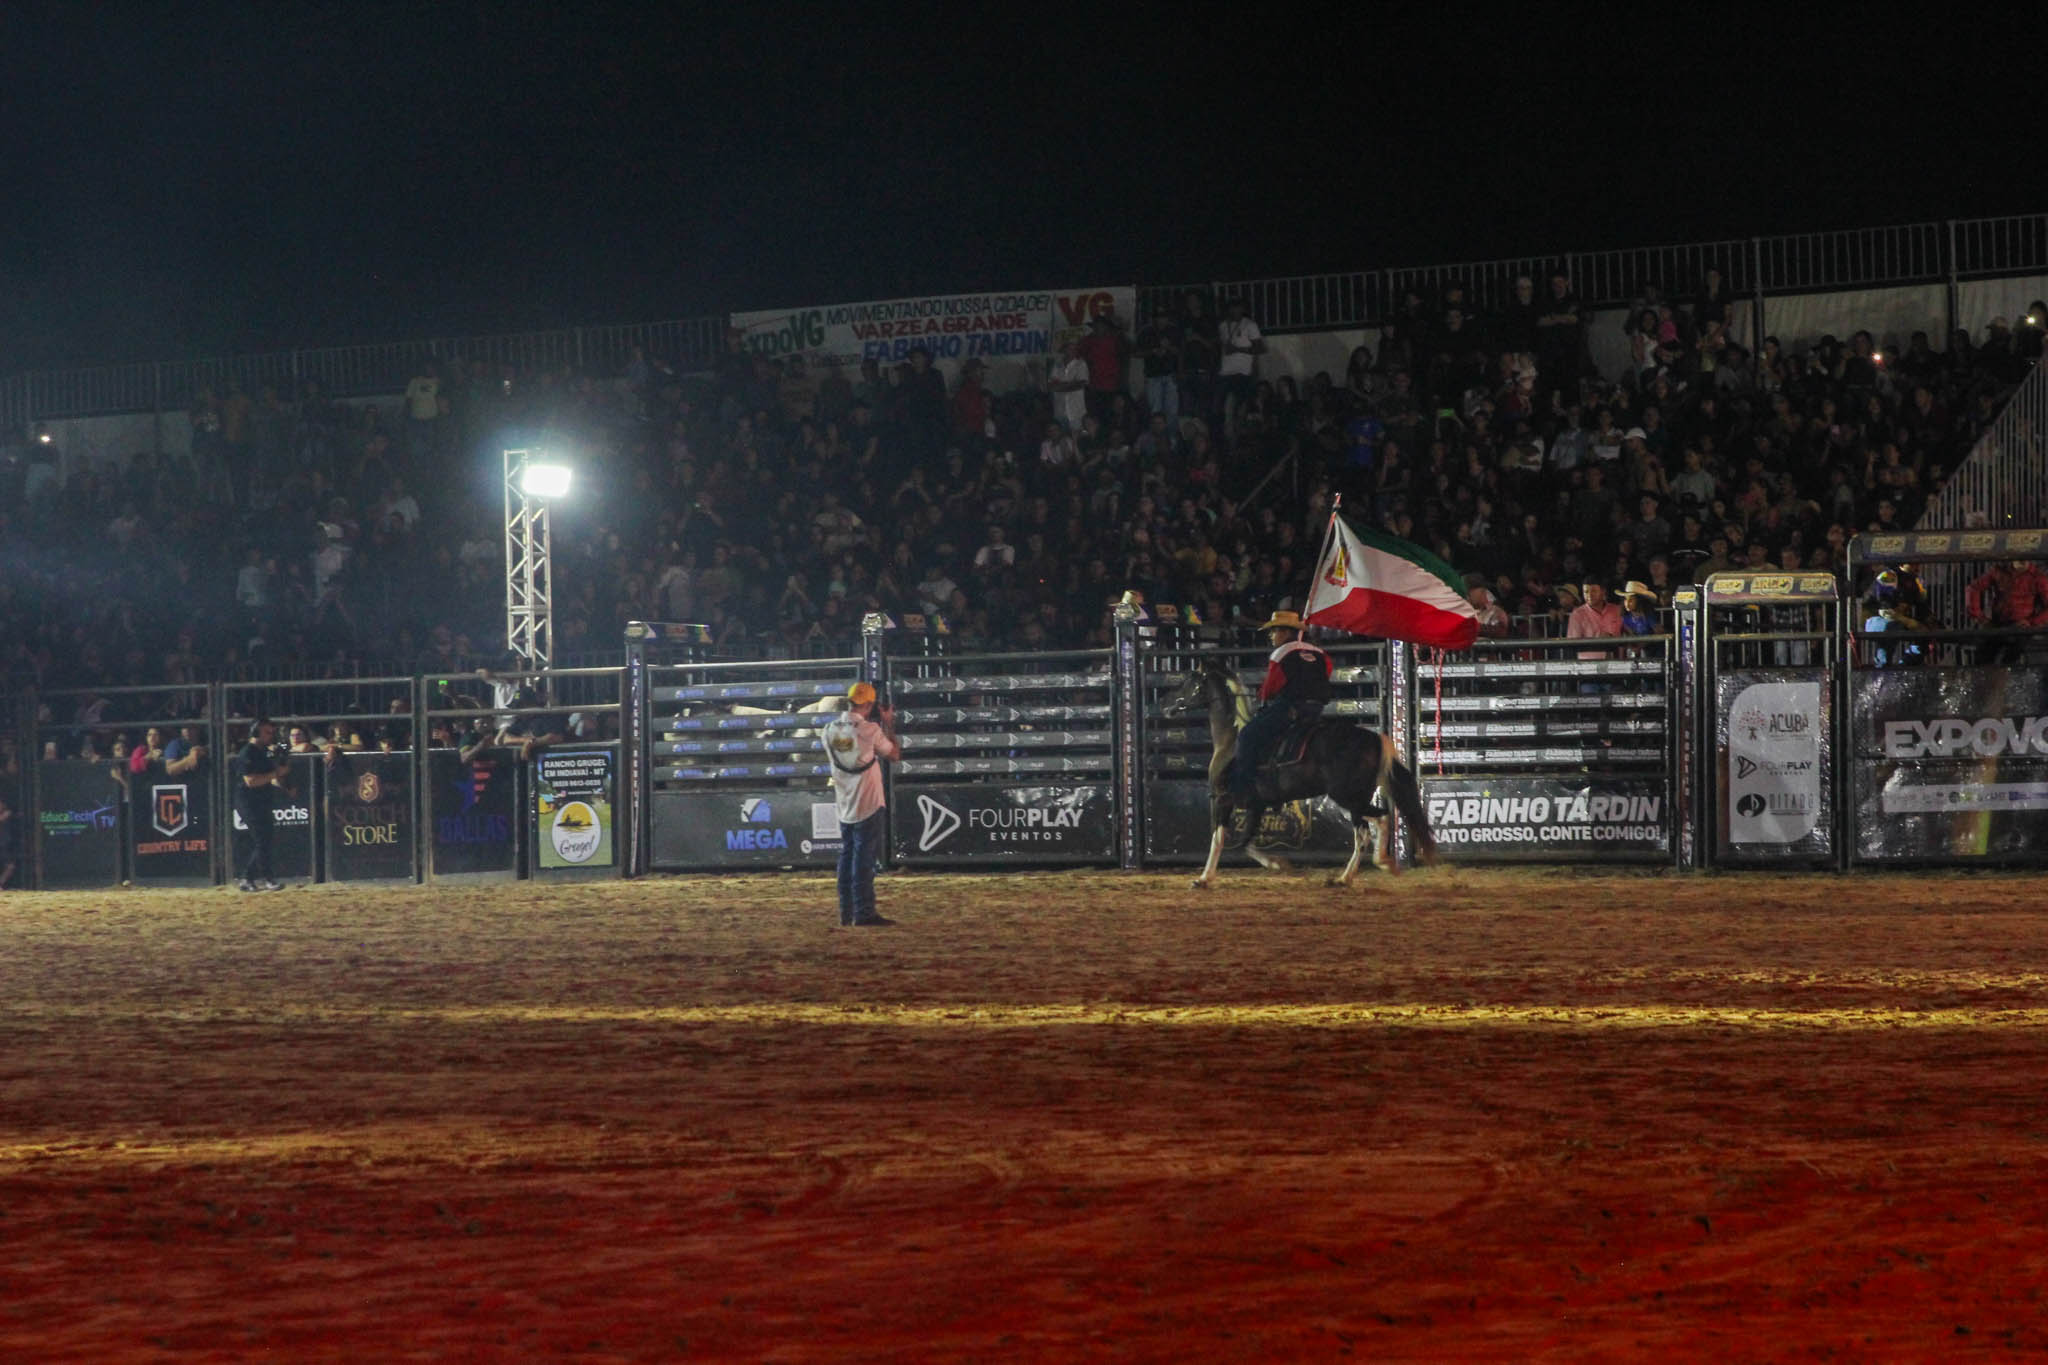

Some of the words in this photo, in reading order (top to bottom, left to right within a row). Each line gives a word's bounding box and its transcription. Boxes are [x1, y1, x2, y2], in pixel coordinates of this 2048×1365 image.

[826, 300, 942, 326] MOVIMENTANDO
[943, 296, 991, 316] NOSSA
[943, 312, 1028, 333] GRANDE
[967, 329, 1049, 357] TARDIN
[544, 760, 576, 769] RANCHO
[969, 807, 1085, 829] FOURPLAY
[1427, 796, 1551, 825] FABINHO
[1553, 796, 1661, 822] TARDIN
[343, 824, 399, 846] STORE
[726, 828, 789, 851] MEGA
[990, 831, 1064, 841] EVENTOS
[1470, 827, 1539, 844] GROSSO,
[1539, 826, 1592, 842] CONTE
[1592, 825, 1661, 842] COMIGO!
